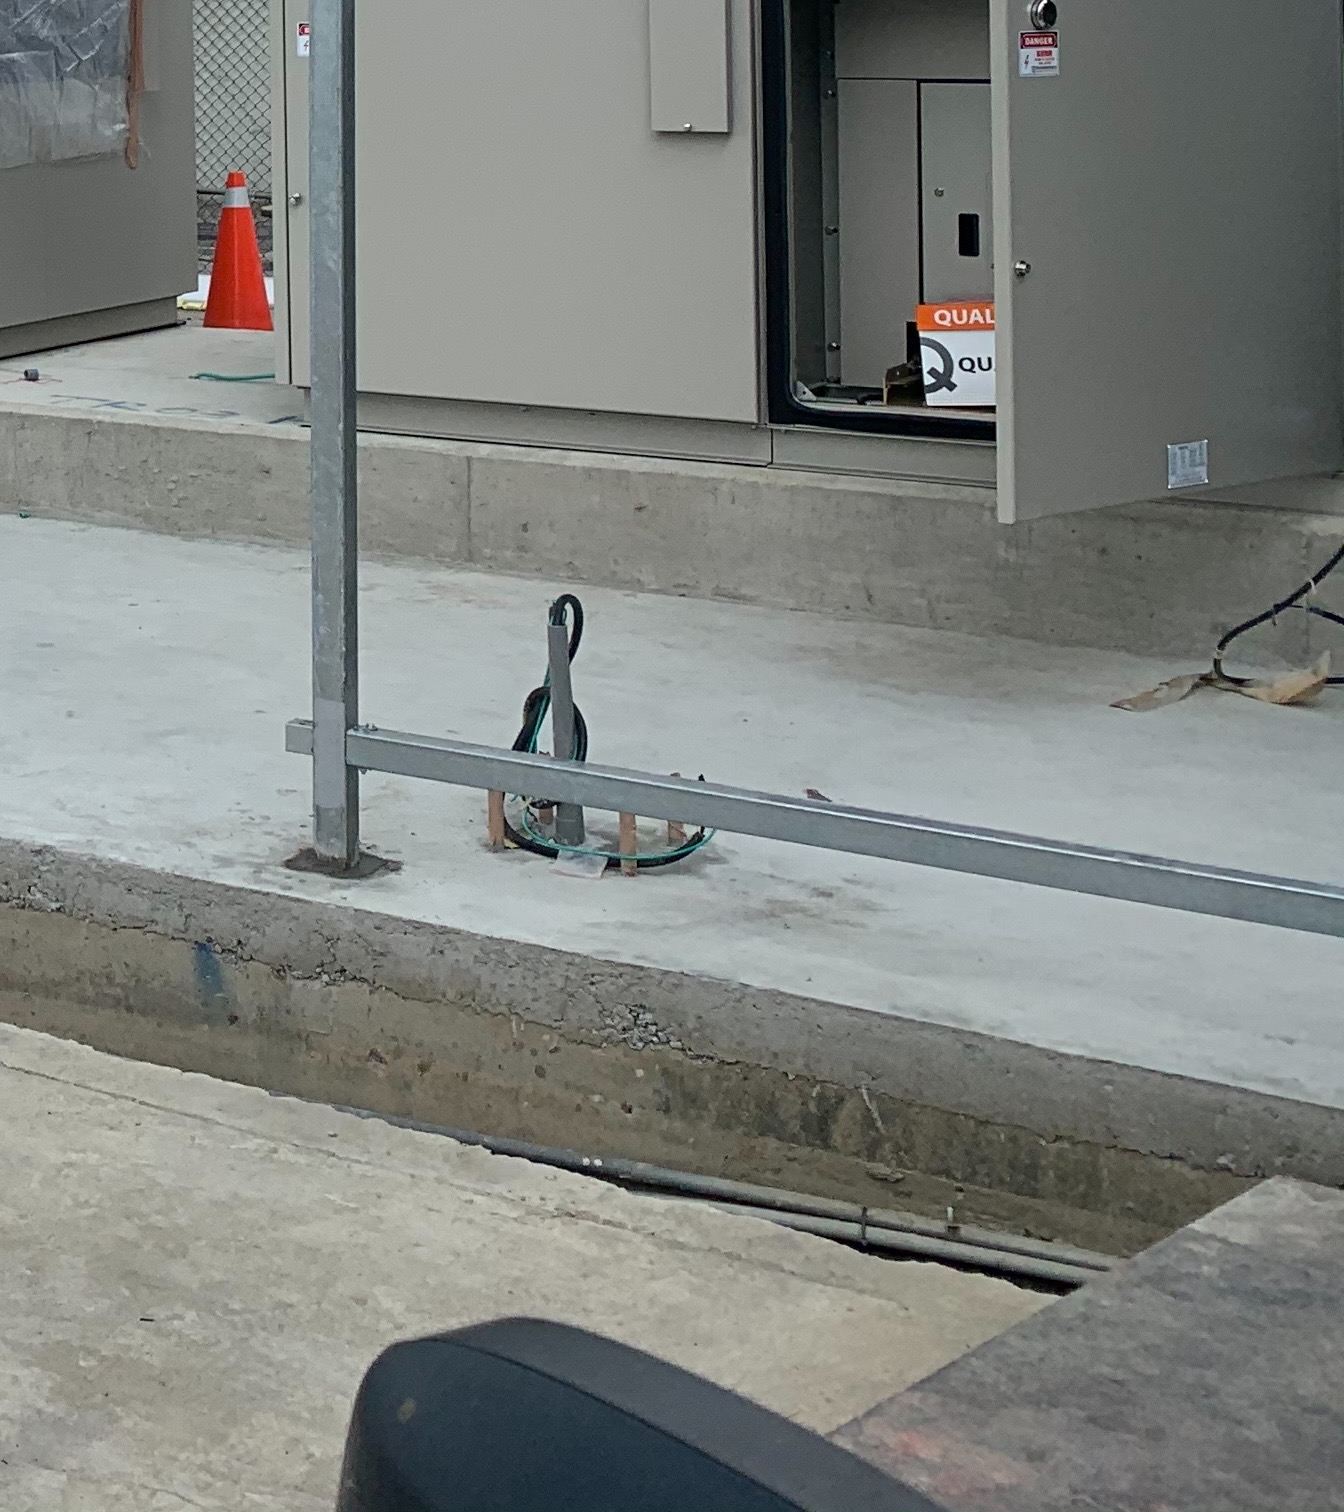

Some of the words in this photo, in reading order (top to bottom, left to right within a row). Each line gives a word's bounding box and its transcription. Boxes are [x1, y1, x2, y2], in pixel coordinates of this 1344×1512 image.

[1024, 37, 1053, 45] DANGER
[934, 308, 995, 327] QUAL
[958, 356, 996, 374] QU
